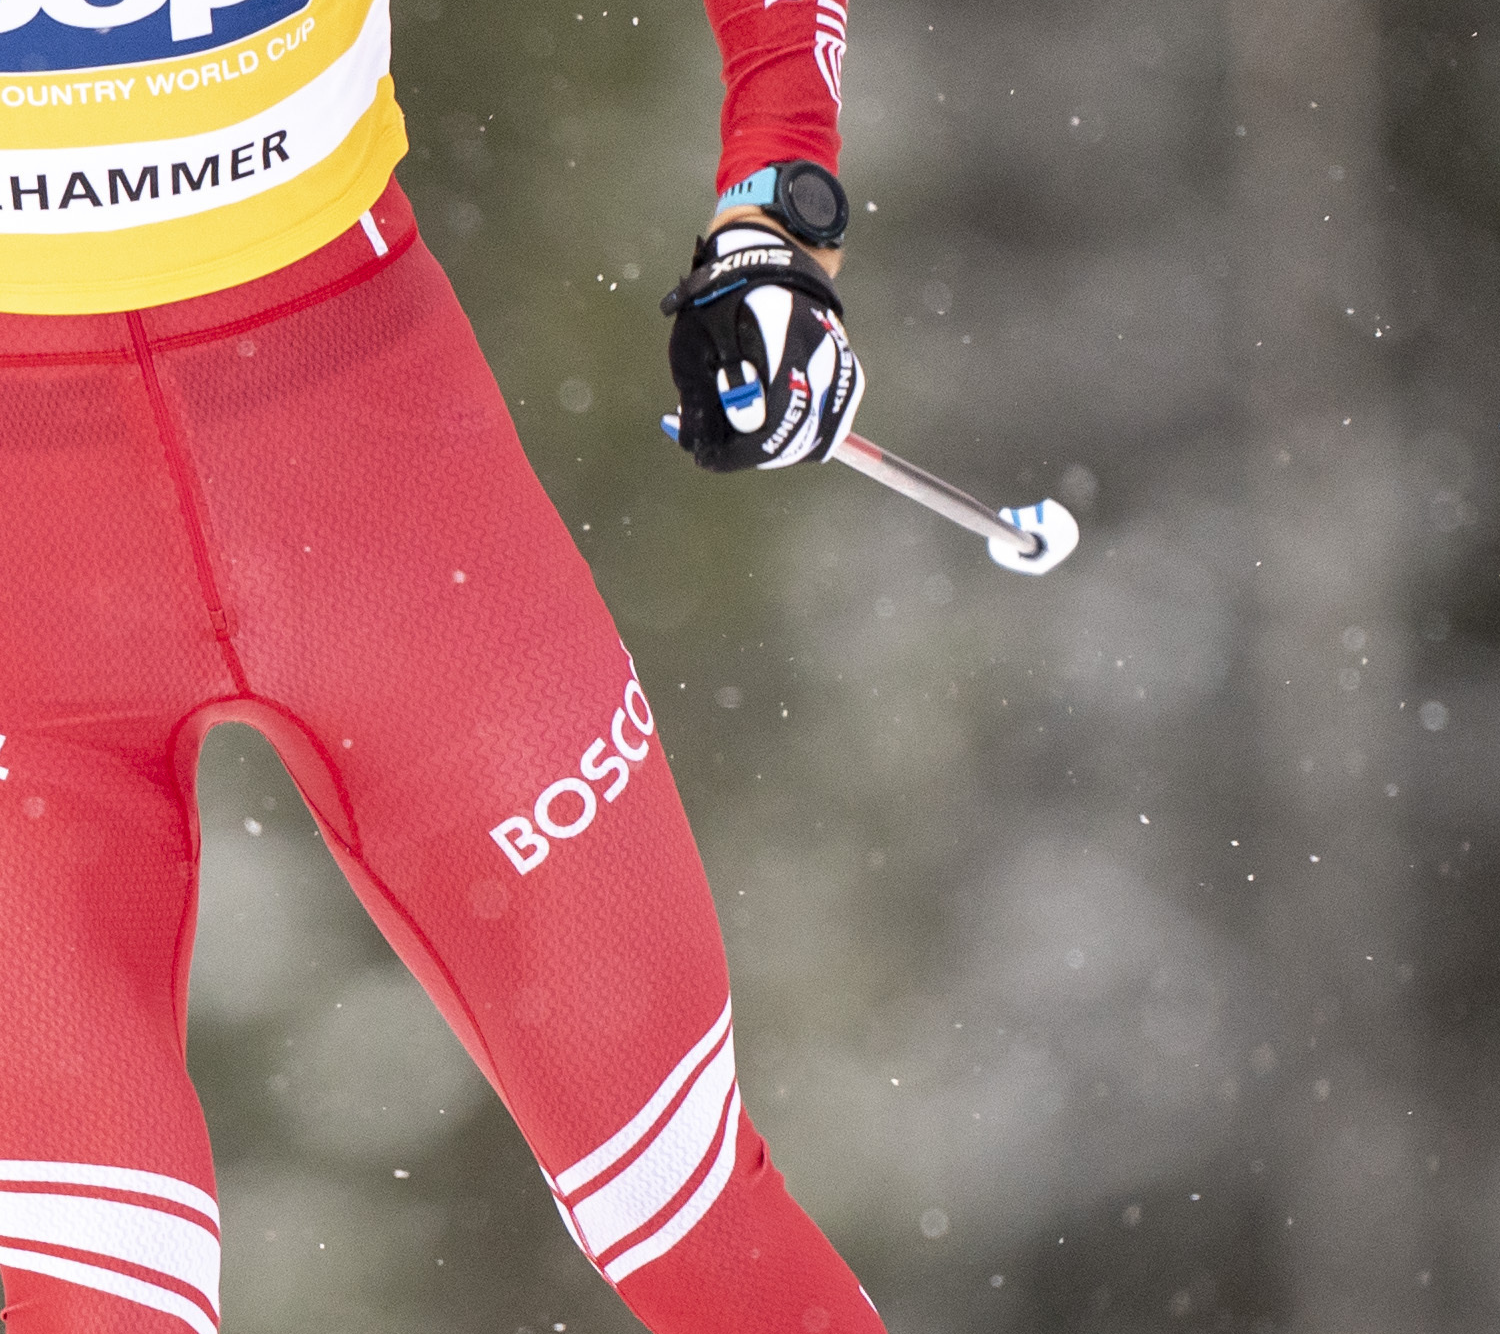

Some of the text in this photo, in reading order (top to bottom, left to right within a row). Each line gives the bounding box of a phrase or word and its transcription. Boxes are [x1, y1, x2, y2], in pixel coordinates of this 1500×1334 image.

[146, 50, 260, 98] WORLD
[266, 17, 316, 62] CUP
[488, 678, 655, 876] BOSCO
